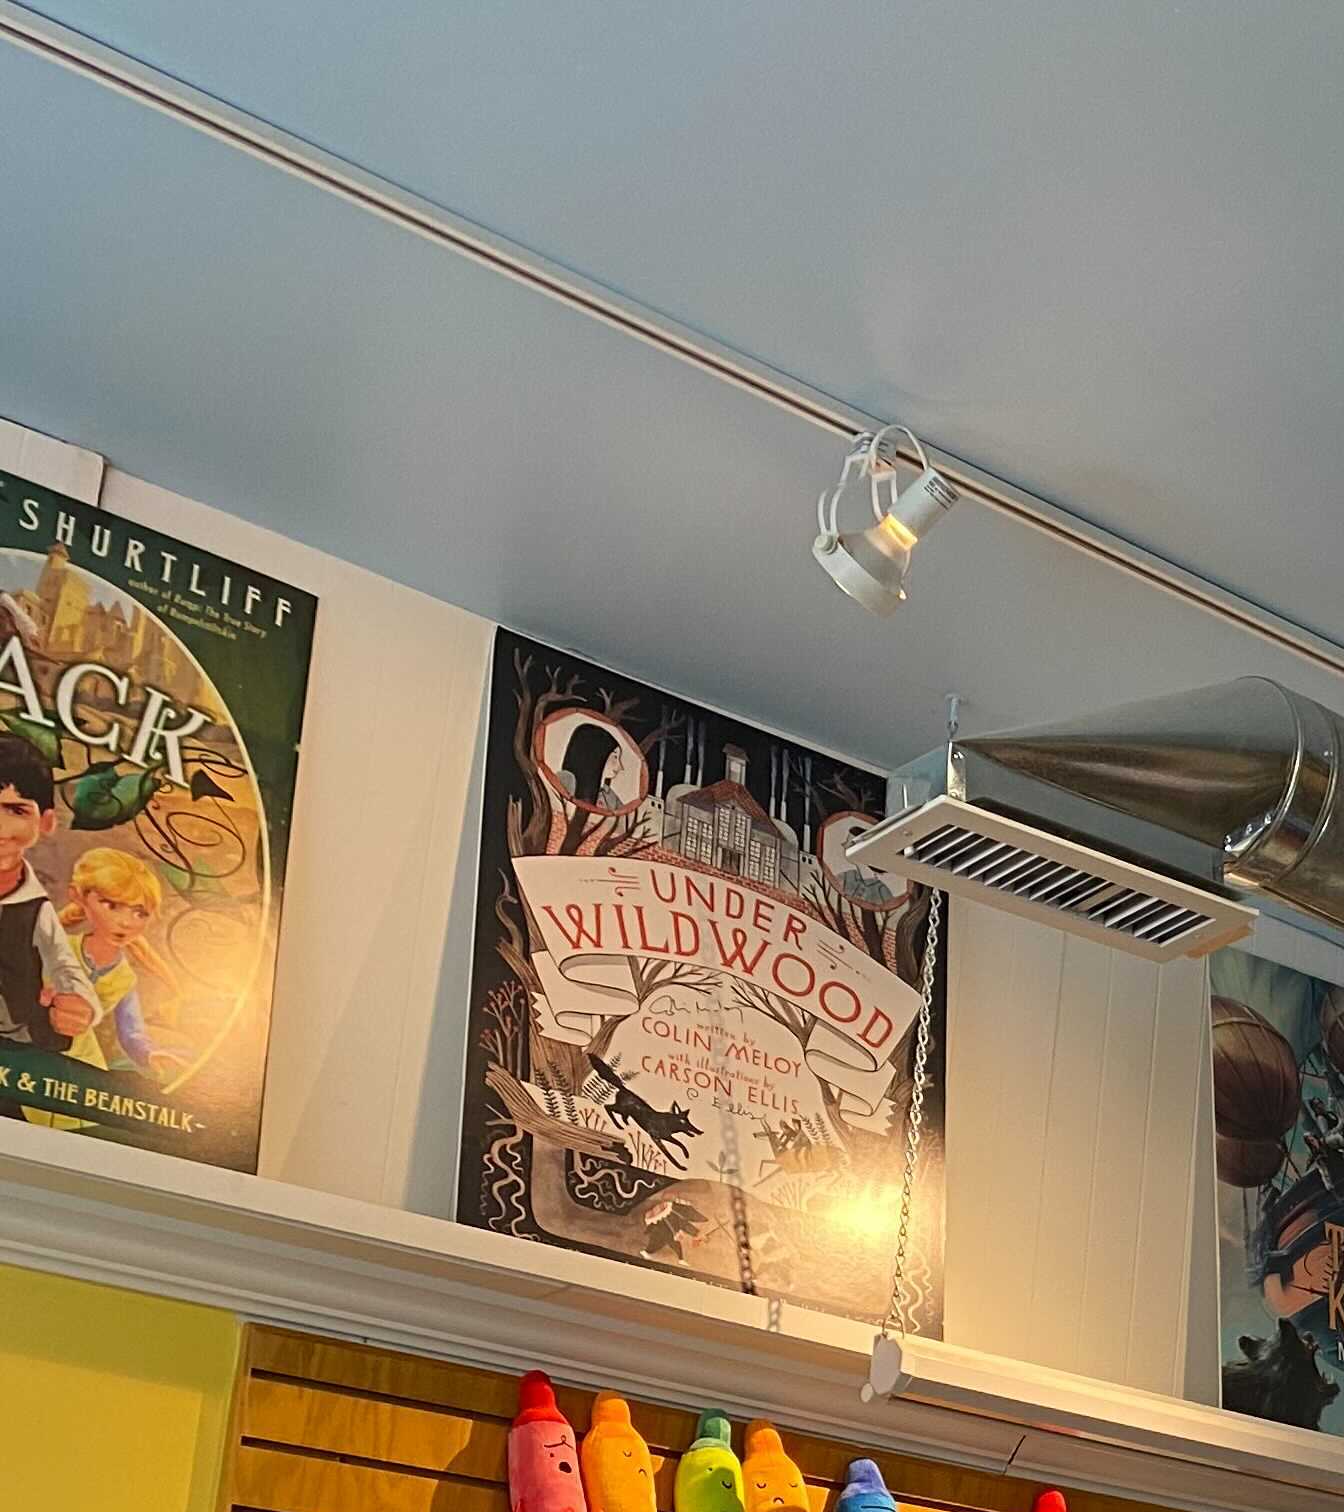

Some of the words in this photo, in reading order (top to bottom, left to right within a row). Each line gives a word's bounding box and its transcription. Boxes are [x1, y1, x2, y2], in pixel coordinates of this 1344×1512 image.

[19, 498, 293, 628] SHURTLIFF
[650, 868, 808, 952] UNDER
[541, 903, 895, 1050] WILDWOOD
[641, 1016, 712, 1052] COLIN
[725, 1042, 802, 1079] MELOY
[641, 1056, 732, 1097] CARSON
[747, 1086, 801, 1115] ELLIS
